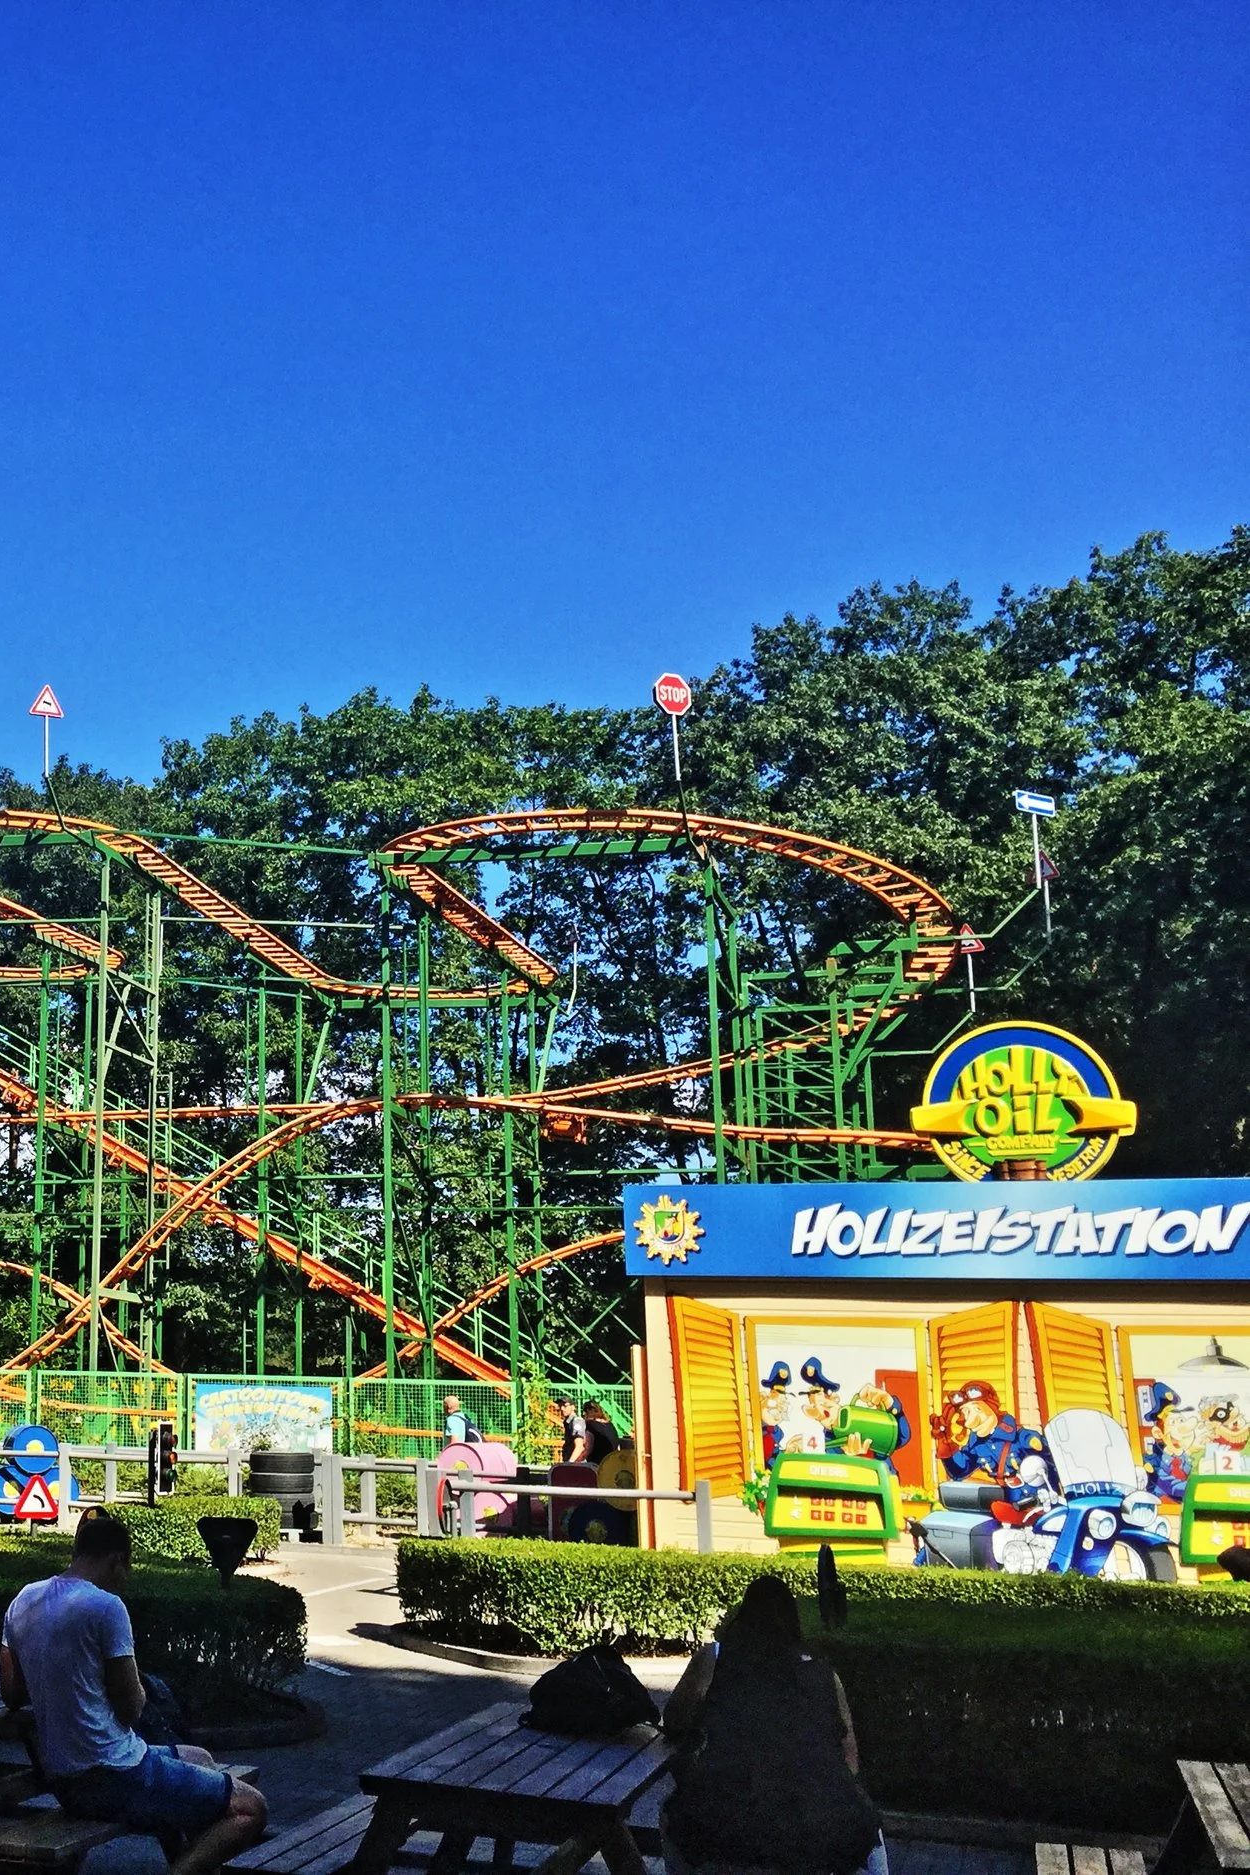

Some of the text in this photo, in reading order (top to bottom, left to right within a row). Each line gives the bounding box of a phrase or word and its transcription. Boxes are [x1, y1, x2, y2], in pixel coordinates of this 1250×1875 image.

[659, 685, 687, 703] STOP
[958, 1047, 1076, 1101] HOLLY
[986, 1134, 1059, 1150] COMPANY
[791, 1201, 1250, 1257] HOLIZEISTATION
[807, 1437, 818, 1449] 4
[1222, 1456, 1233, 1470] 2
